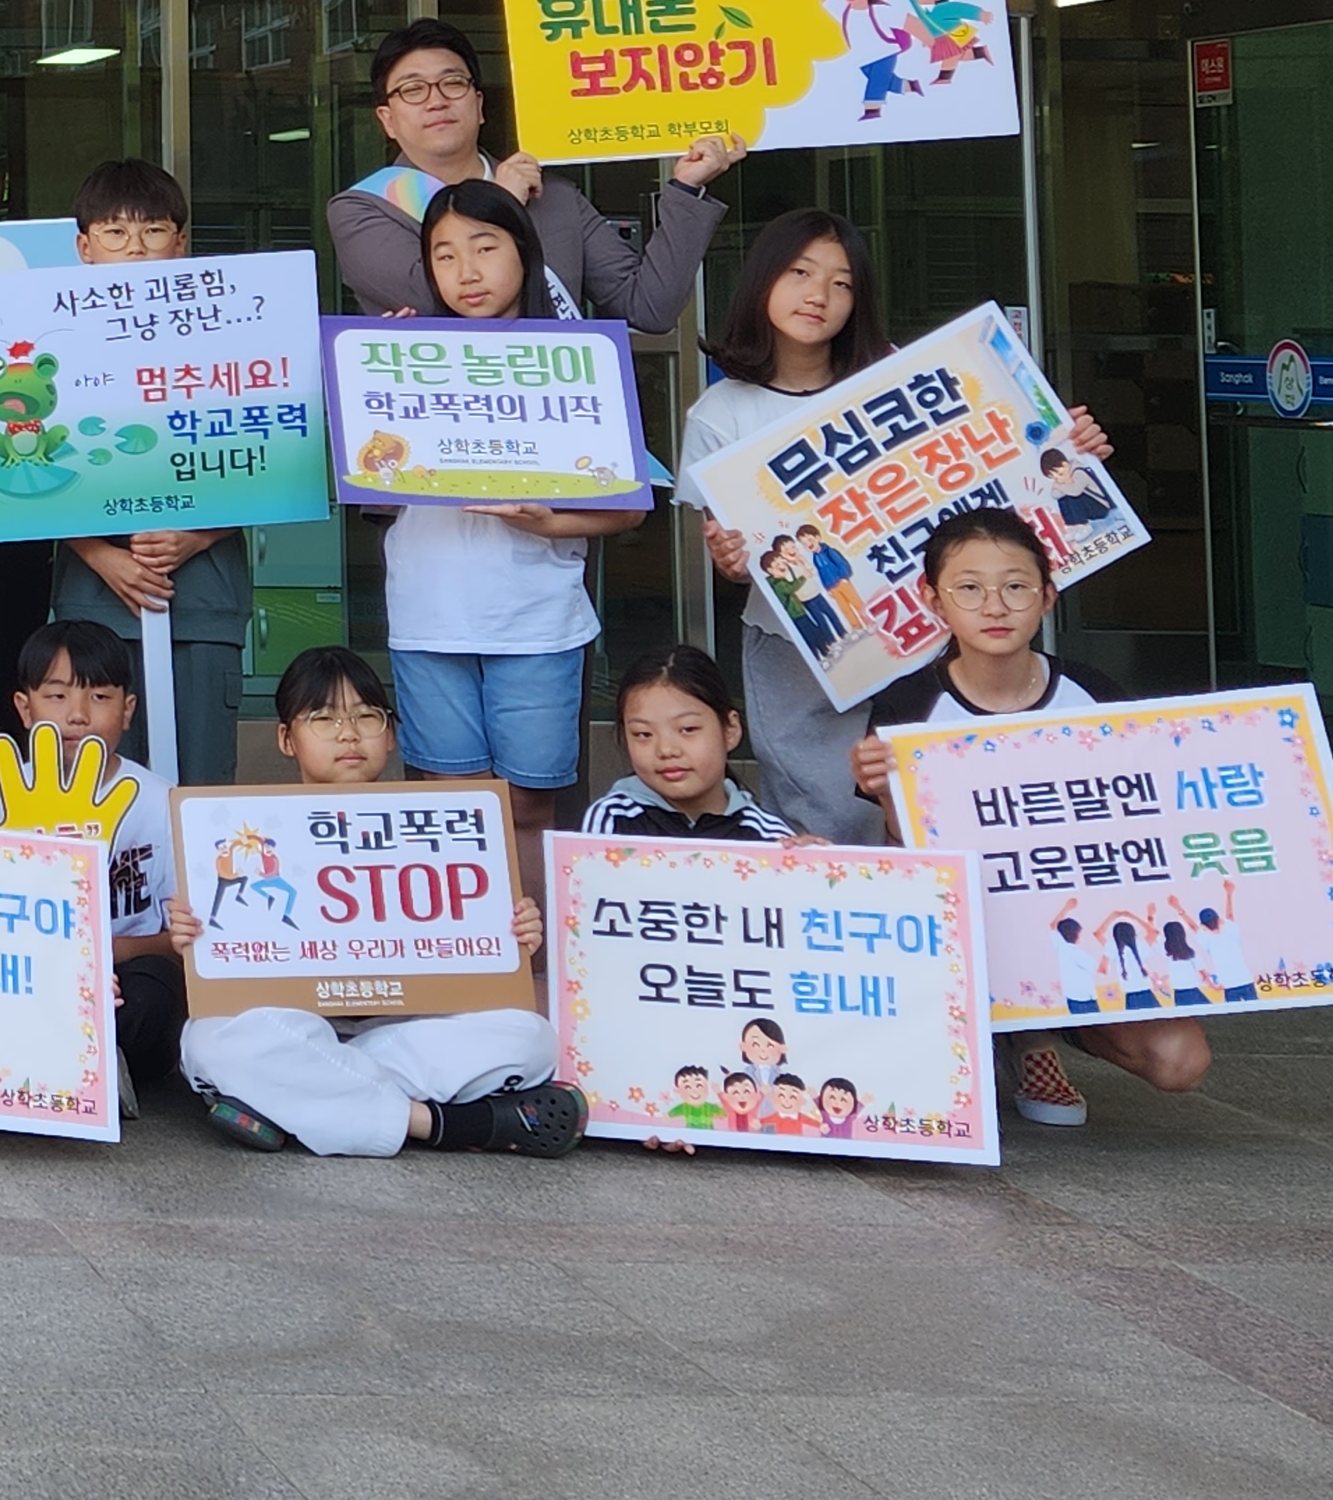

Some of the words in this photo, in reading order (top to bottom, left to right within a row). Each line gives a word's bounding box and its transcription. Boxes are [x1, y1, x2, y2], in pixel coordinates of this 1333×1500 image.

[570, 36, 777, 98] 보지않기
[567, 123, 661, 144] 상학초등학교
[667, 119, 730, 138] 학부모회
[53, 282, 134, 318] 사소한
[144, 268, 236, 303] 괴롭힘,
[105, 315, 159, 342] 그냥
[74, 372, 115, 388] 아야
[135, 357, 289, 402] 멈추세요!
[360, 342, 452, 385] 작은
[461, 344, 596, 386] 놀림이
[166, 403, 308, 446] 학교폭력
[363, 391, 528, 424] 학교폭력의
[538, 395, 602, 425] 시작
[437, 438, 539, 455] 상학초등학교
[767, 367, 970, 502] 무심코한
[170, 446, 266, 482] 입니다!
[817, 462, 920, 543] 작은
[914, 410, 1021, 493] 장난
[103, 494, 195, 515] 상학초등학교
[972, 772, 1161, 828] 바른말엔
[1176, 762, 1265, 810] 사랑
[307, 809, 487, 854] 학교폭력
[982, 837, 1171, 893] 고운말엔
[1182, 828, 1278, 878] 웃음
[317, 863, 489, 924] STOP
[591, 897, 727, 945] 소중한
[742, 906, 784, 948] 내
[800, 908, 943, 956] 친구야
[211, 940, 290, 963] 폭력없는
[299, 939, 338, 961] 세상
[347, 939, 405, 959] 우리가
[415, 937, 501, 958] 만들어요!
[638, 962, 774, 1010] 오늘도
[790, 971, 896, 1016] 힘내!
[0, 1088, 98, 1116] 상학초등학교
[863, 1116, 972, 1138] 상학초등학교
